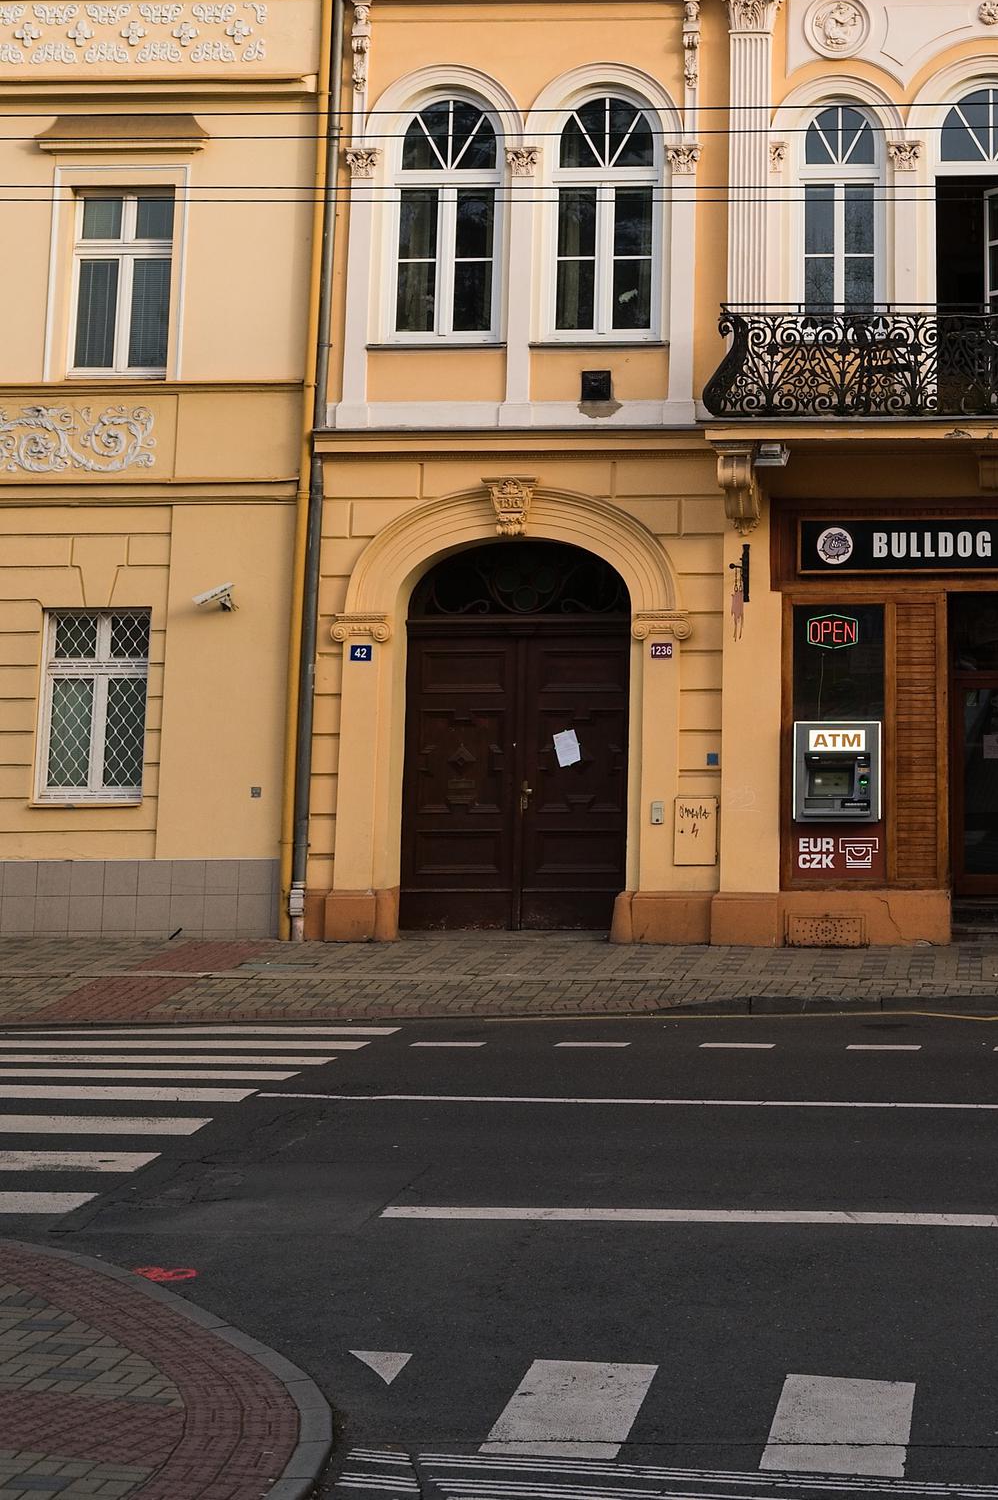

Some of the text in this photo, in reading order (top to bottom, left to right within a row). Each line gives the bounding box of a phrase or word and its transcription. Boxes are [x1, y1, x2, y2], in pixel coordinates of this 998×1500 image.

[872, 531, 992, 558] BULLDOG
[810, 621, 856, 643] OPEN
[354, 648, 367, 658] 42
[651, 646, 672, 656] 1236
[813, 733, 861, 747] ATM
[799, 838, 834, 852] EUR
[798, 854, 835, 868] CZK
